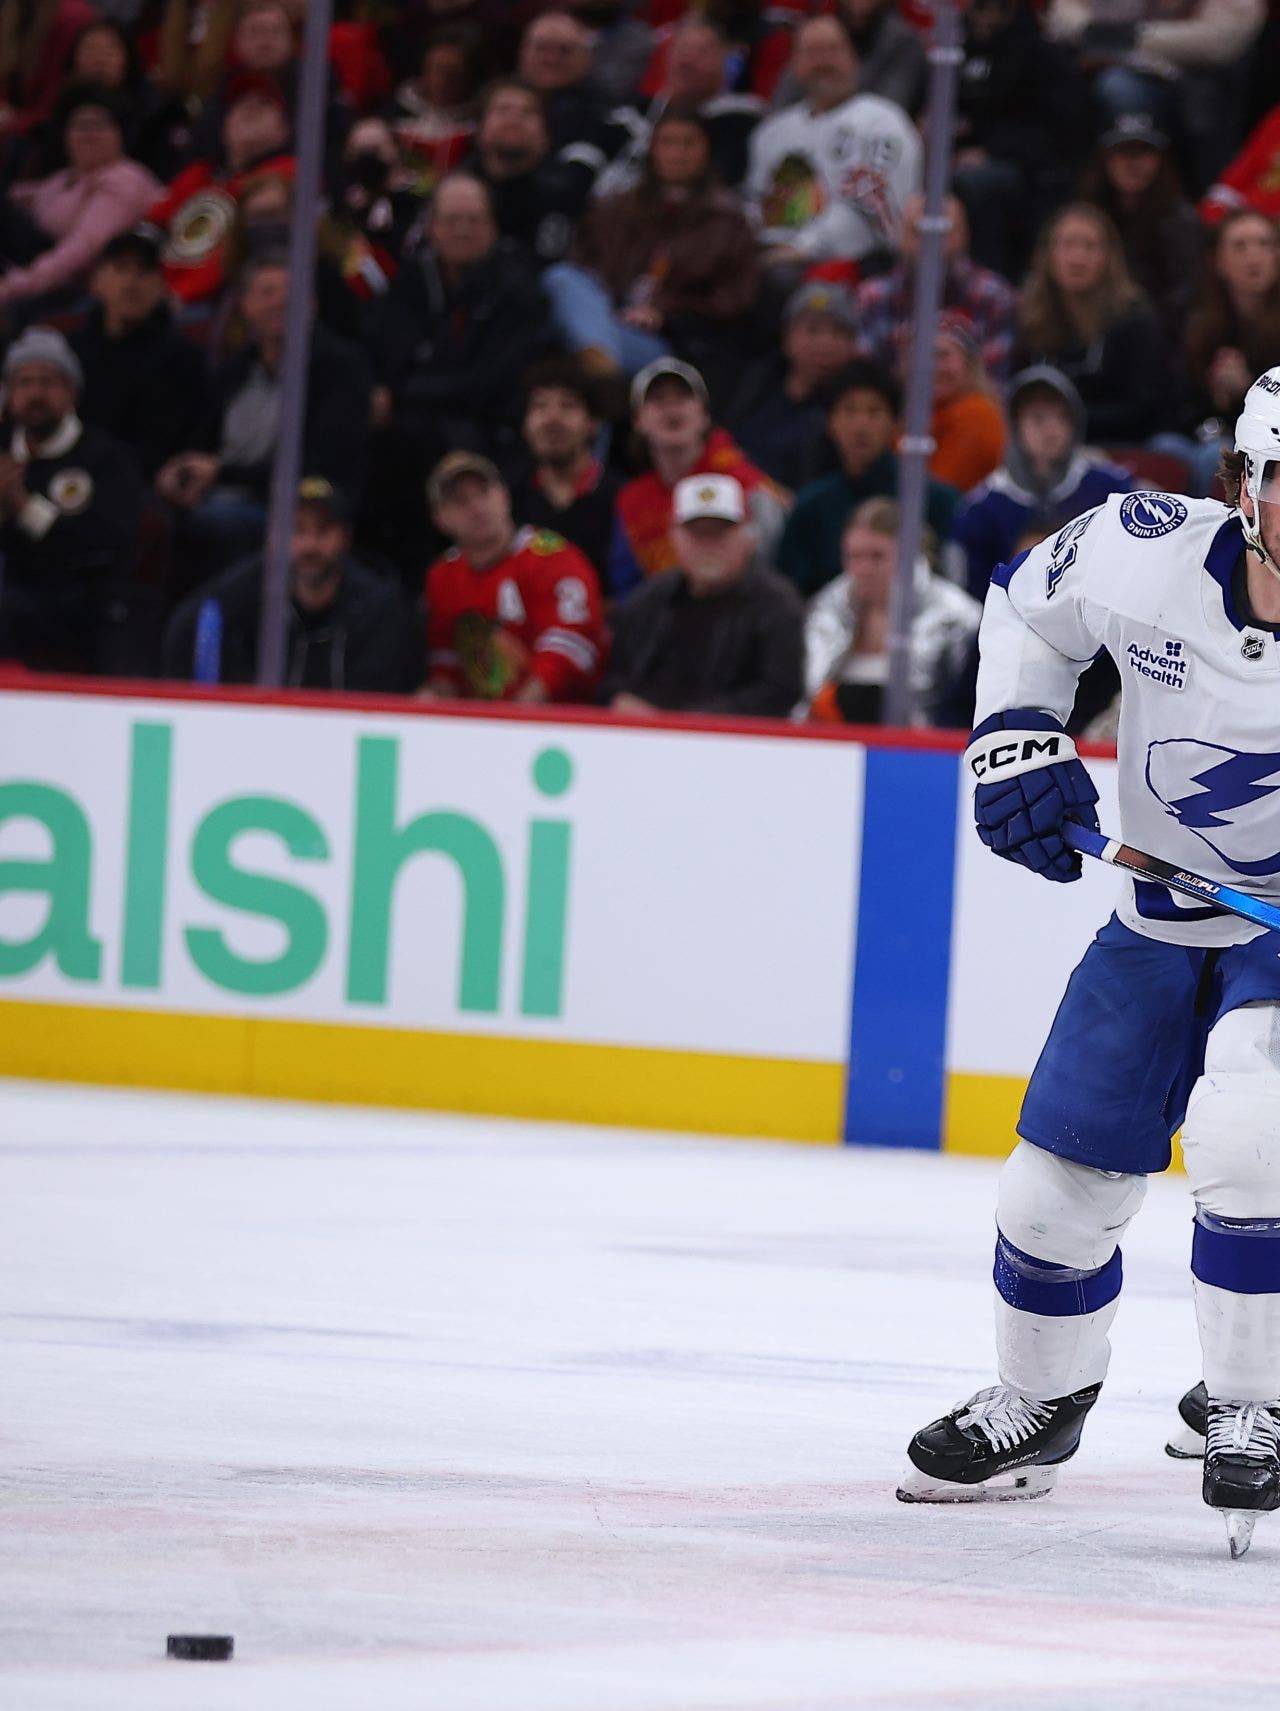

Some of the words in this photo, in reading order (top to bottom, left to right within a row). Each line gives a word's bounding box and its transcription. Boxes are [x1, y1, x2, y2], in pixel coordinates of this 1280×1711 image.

[1127, 518, 1182, 537] LIGHTNING
[1126, 643, 1187, 674] Advent
[1244, 643, 1264, 656] NHL
[1130, 656, 1184, 689] Health
[971, 737, 1060, 778] CCM
[0, 718, 575, 1021] alshi
